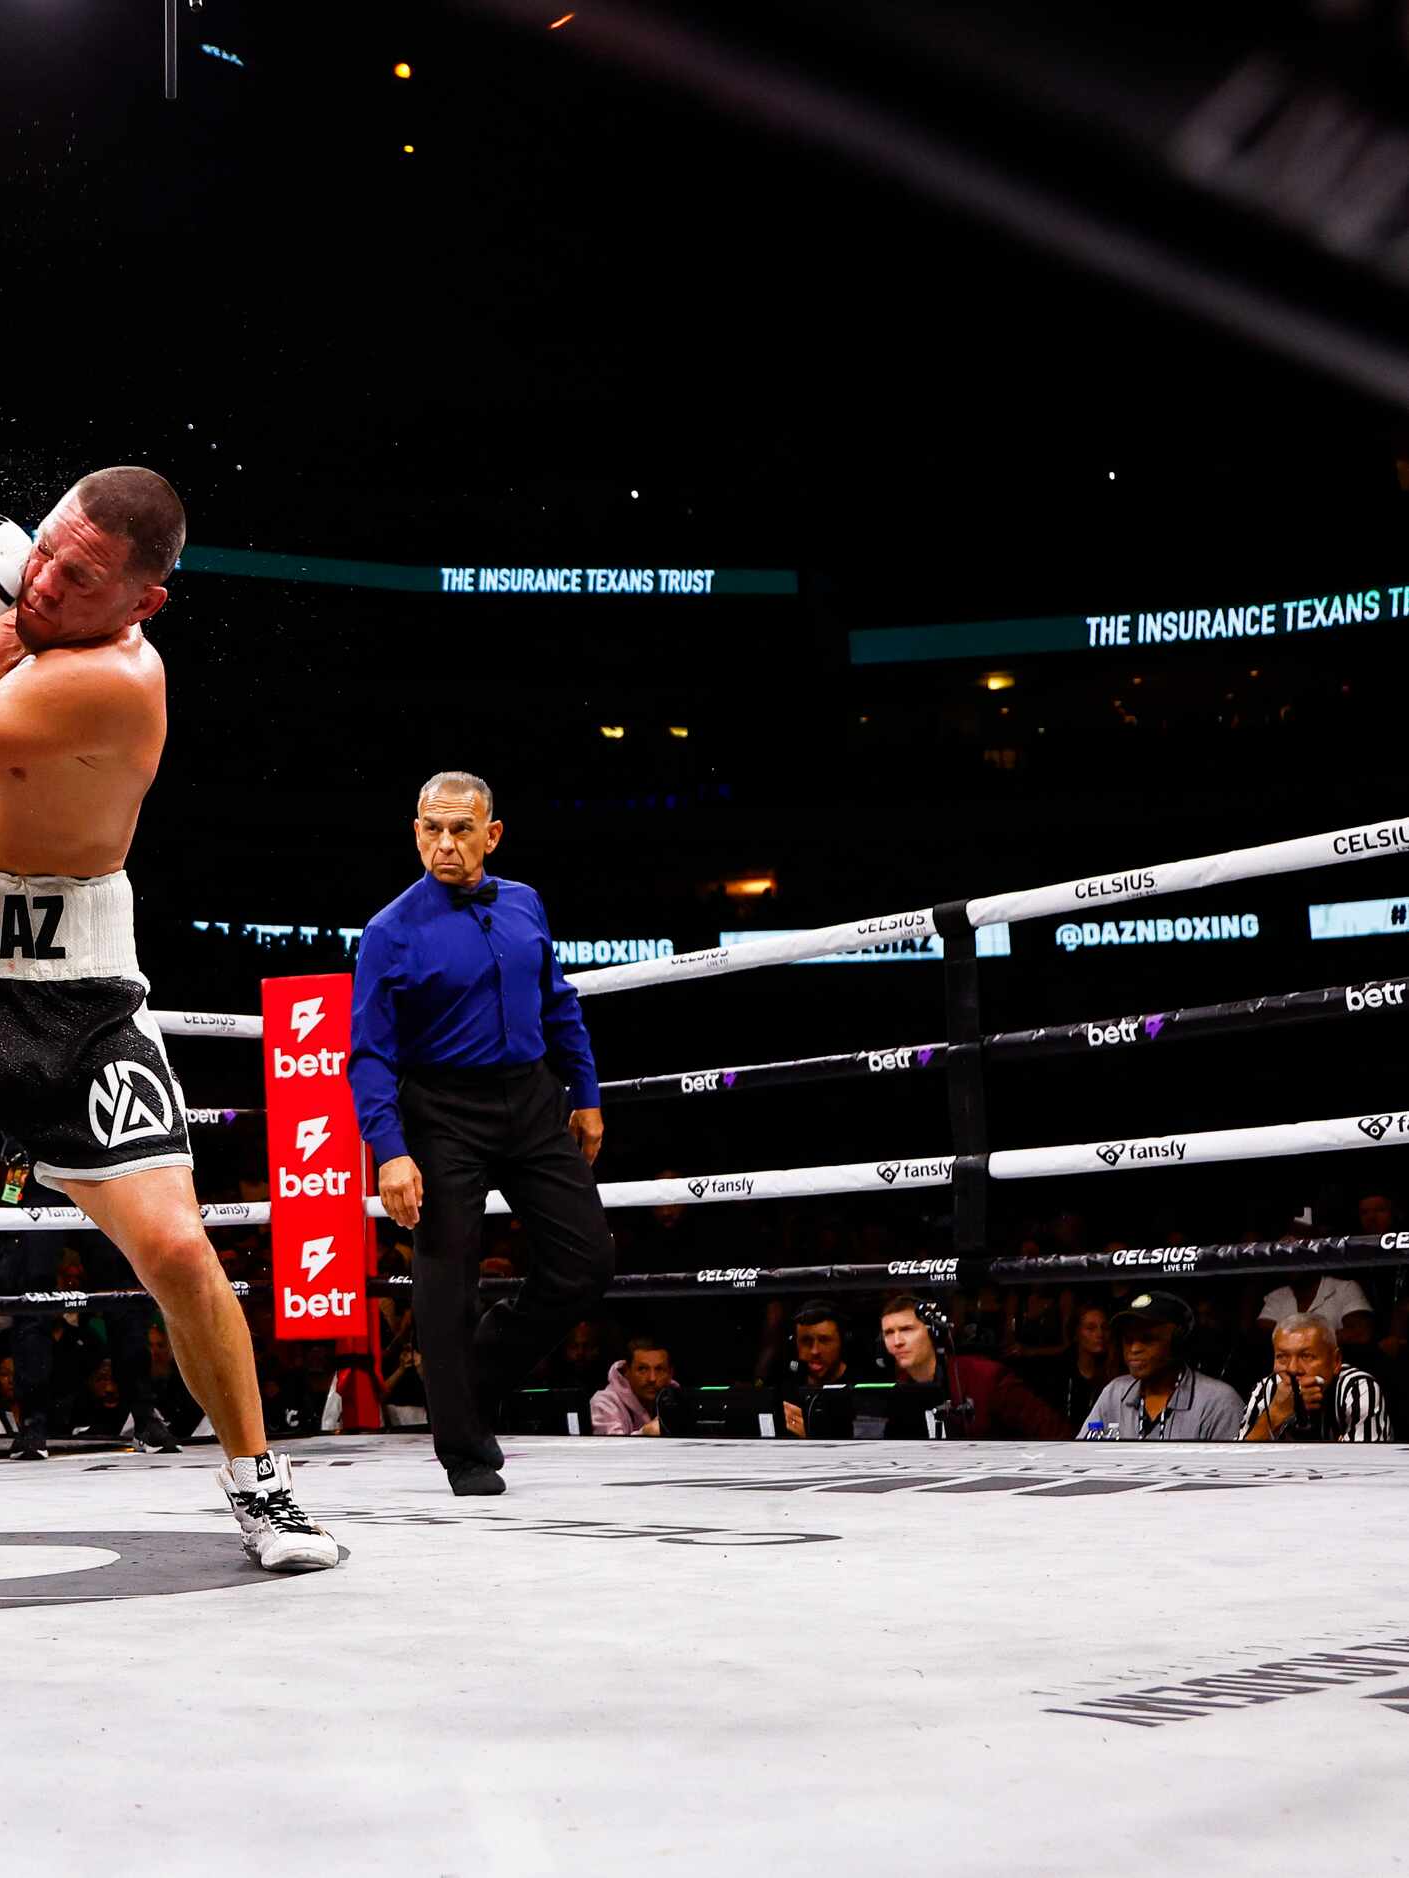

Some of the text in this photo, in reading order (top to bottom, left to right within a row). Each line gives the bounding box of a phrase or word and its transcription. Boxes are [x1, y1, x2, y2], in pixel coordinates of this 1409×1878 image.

[441, 567, 715, 594] THE INSURANCE TEXANS TRUST
[1086, 615, 1131, 647] THE
[1137, 604, 1276, 644] INSURANCE
[1282, 590, 1381, 632] TEXANS
[1075, 871, 1156, 899] CELSIUS
[1055, 913, 1260, 951] @DAZNBOXING
[552, 938, 674, 965] NBOXING
[1345, 980, 1406, 1012] betr
[1087, 1022, 1139, 1048] betr
[274, 1047, 345, 1079] betr
[868, 1047, 911, 1074] betr
[681, 1073, 719, 1093] betr
[186, 1108, 221, 1124] betr
[1129, 1140, 1187, 1161] fansly
[279, 1167, 351, 1199] betr
[904, 1160, 953, 1180] fansly
[711, 1178, 755, 1195] fansly
[215, 1204, 251, 1218] fansly
[887, 1258, 959, 1275] CELSIUS
[1112, 1246, 1198, 1265] CELSIUS
[1163, 1263, 1195, 1272] LIVE FIT
[697, 1267, 759, 1282] CELSIUS
[930, 1273, 945, 1281] LIVE
[284, 1287, 356, 1318] betr
[1039, 1652, 1409, 1728] ACADEMY
